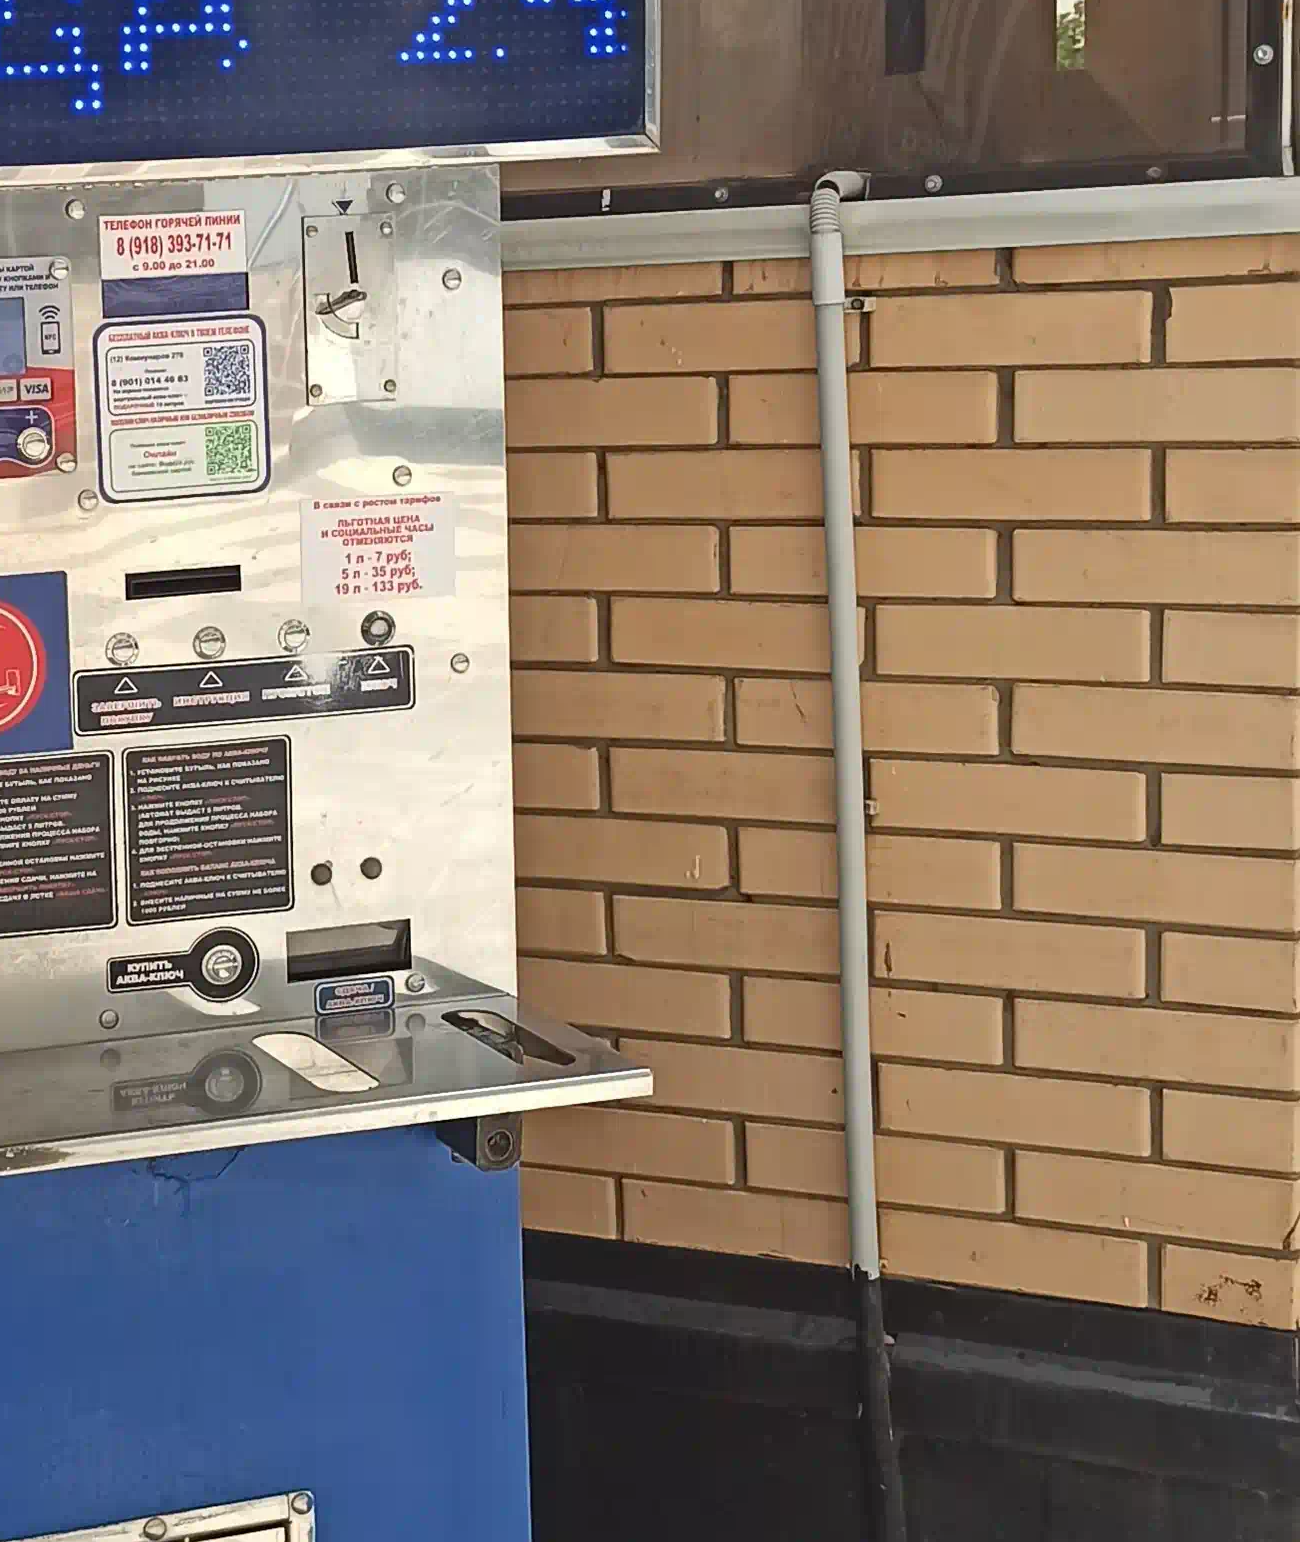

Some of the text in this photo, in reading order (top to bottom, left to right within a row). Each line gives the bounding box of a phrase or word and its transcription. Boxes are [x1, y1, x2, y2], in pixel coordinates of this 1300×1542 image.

[103, 214, 241, 231] ТЕЛЕФОН ГОРЯЧЕЙ ЛИНИИ
[116, 231, 233, 259] 8 (918) 393-71-71
[142, 261, 167, 271] 9.00
[168, 261, 182, 273] до
[185, 258, 215, 270] 21.00
[23, 383, 49, 395] VISA
[337, 514, 421, 528] ЛЬГОТНАЯ ЦЕНА
[331, 526, 402, 538] СОЦИАЛЬНЫЕ
[404, 523, 435, 533] ЧАСЫ
[341, 568, 349, 580] 5
[371, 566, 387, 578] 35
[334, 583, 350, 595] 19
[371, 580, 394, 592] 133
[116, 969, 185, 985] АКВА-КЛЮЧ
